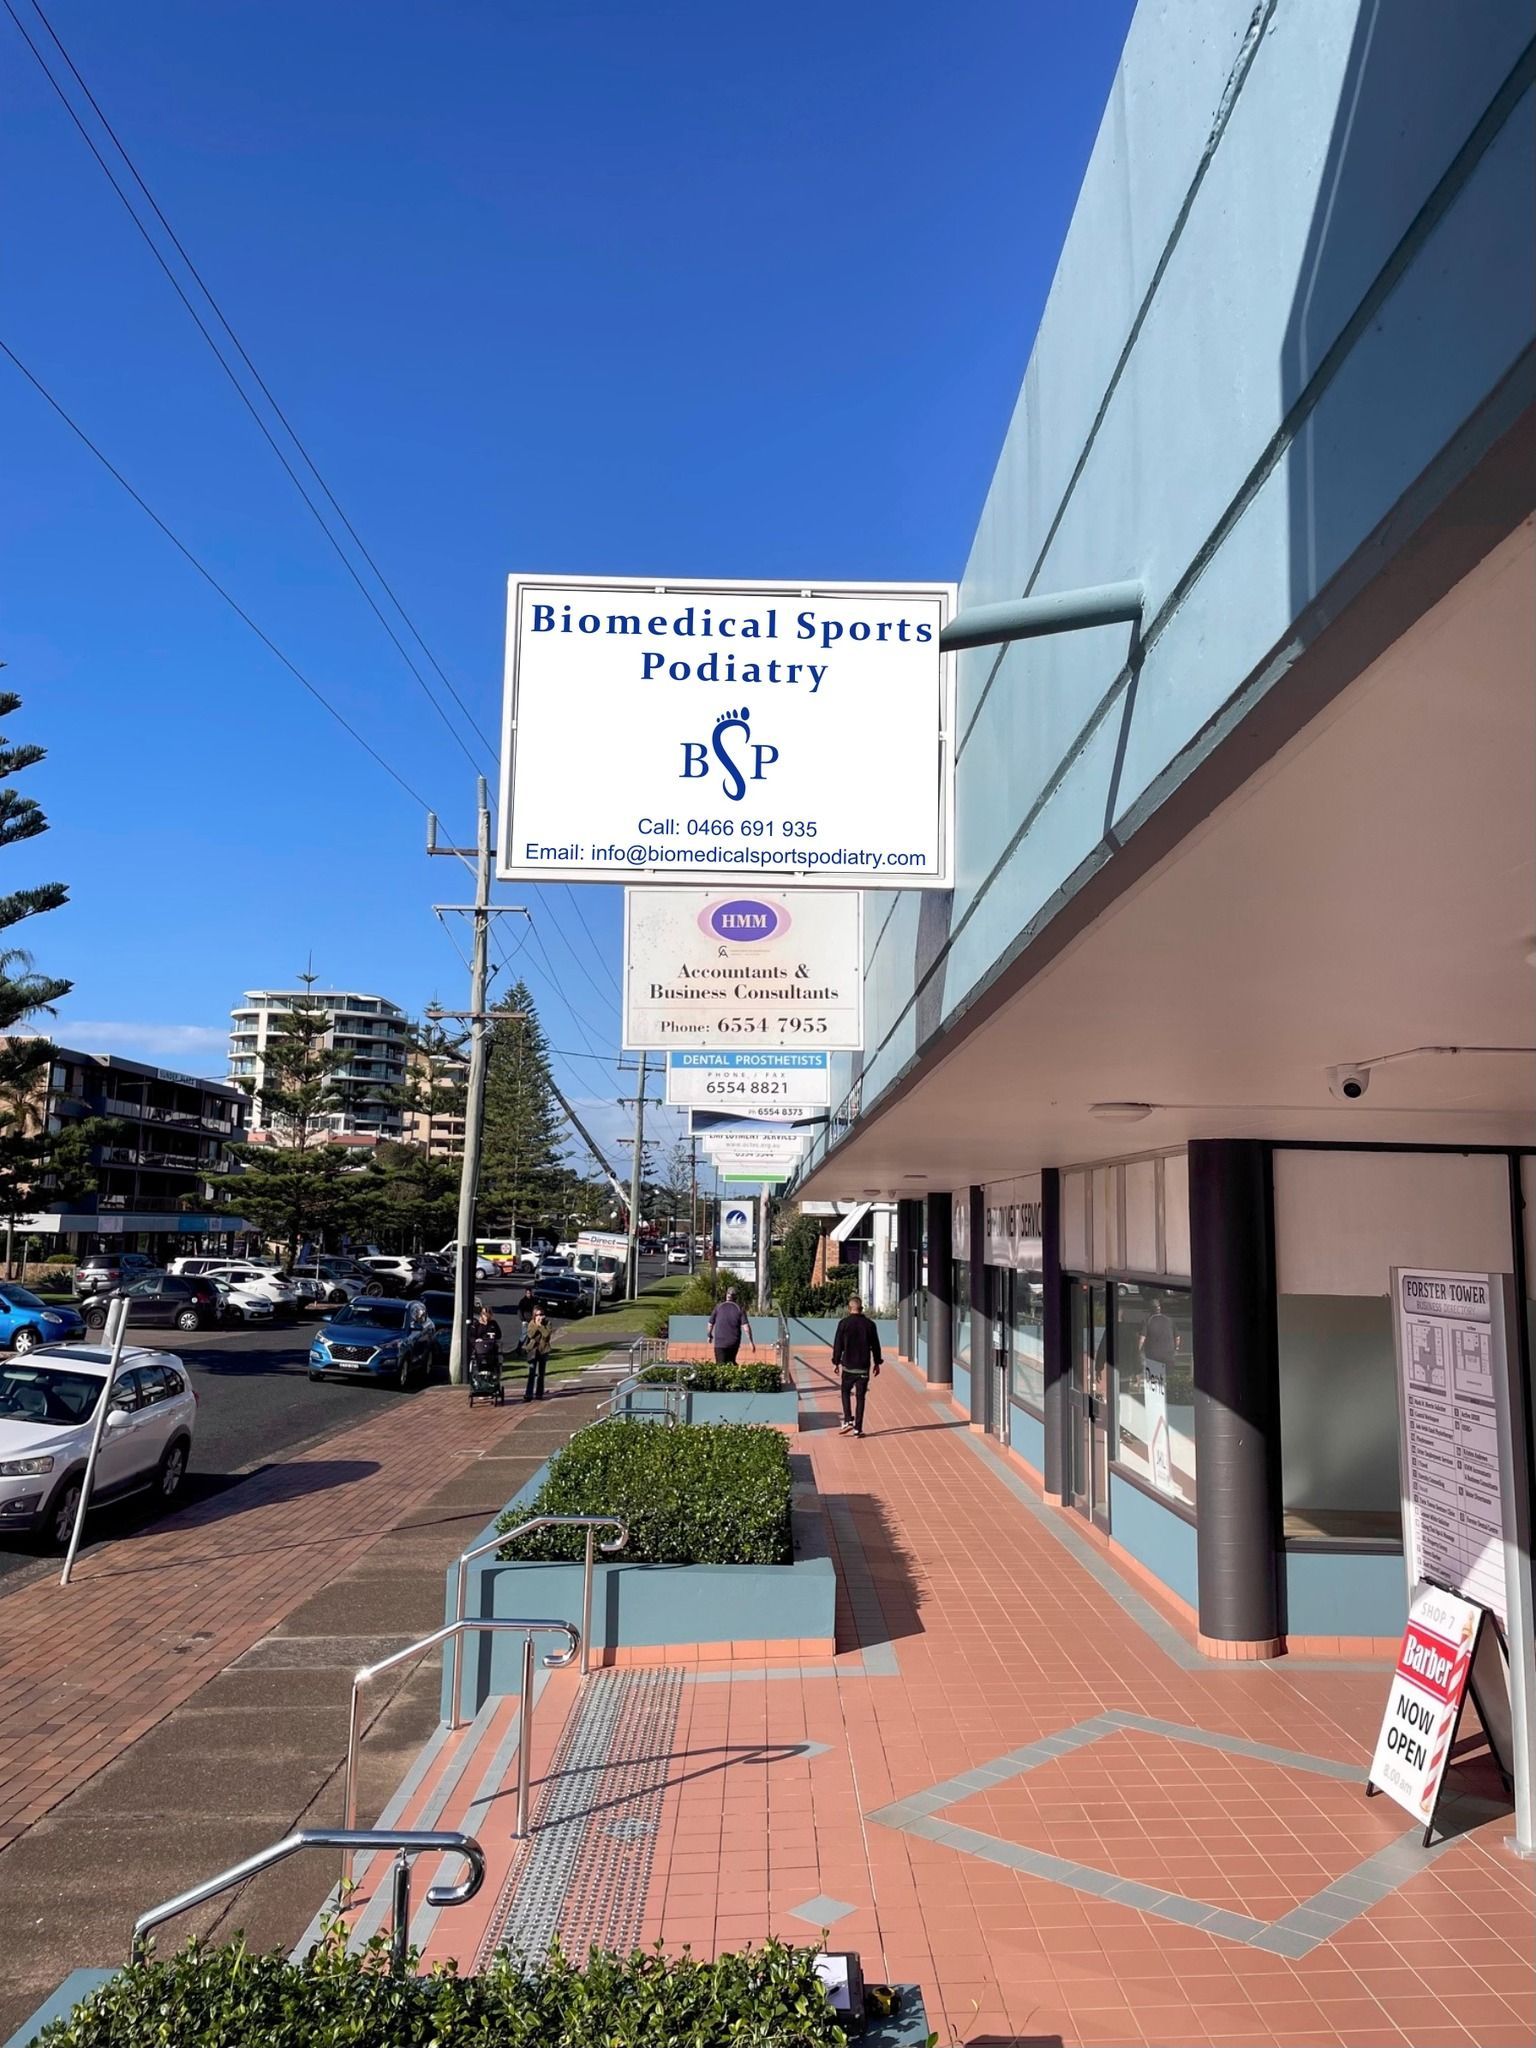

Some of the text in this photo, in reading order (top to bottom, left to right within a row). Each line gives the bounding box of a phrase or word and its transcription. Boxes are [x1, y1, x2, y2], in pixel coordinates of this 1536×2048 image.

[531, 604, 933, 648] Biomedical Sports
[641, 651, 829, 693] Podiatry
[638, 818, 817, 838] Call: 0466 691 935
[526, 843, 926, 869] Email: info@biomedicalsportspodiatry.com
[721, 914, 767, 929] HMM
[678, 963, 810, 979] Accountants &
[650, 983, 839, 1000] Business Consultants
[661, 1017, 828, 1033] Phone: 6554 7955
[683, 1054, 822, 1066] DENTAL PROSTHETISTS
[765, 1071, 785, 1079] FAX
[706, 1081, 788, 1094] 6554 8821
[758, 1107, 780, 1116] 6554
[590, 1236, 617, 1245] Direct
[1407, 1281, 1486, 1304] FORSTER TOWER
[1421, 1602, 1456, 1630] SHOP 7
[1402, 1634, 1453, 1689] Barber
[1396, 1694, 1435, 1735] NOW
[1387, 1727, 1427, 1771] OPEN
